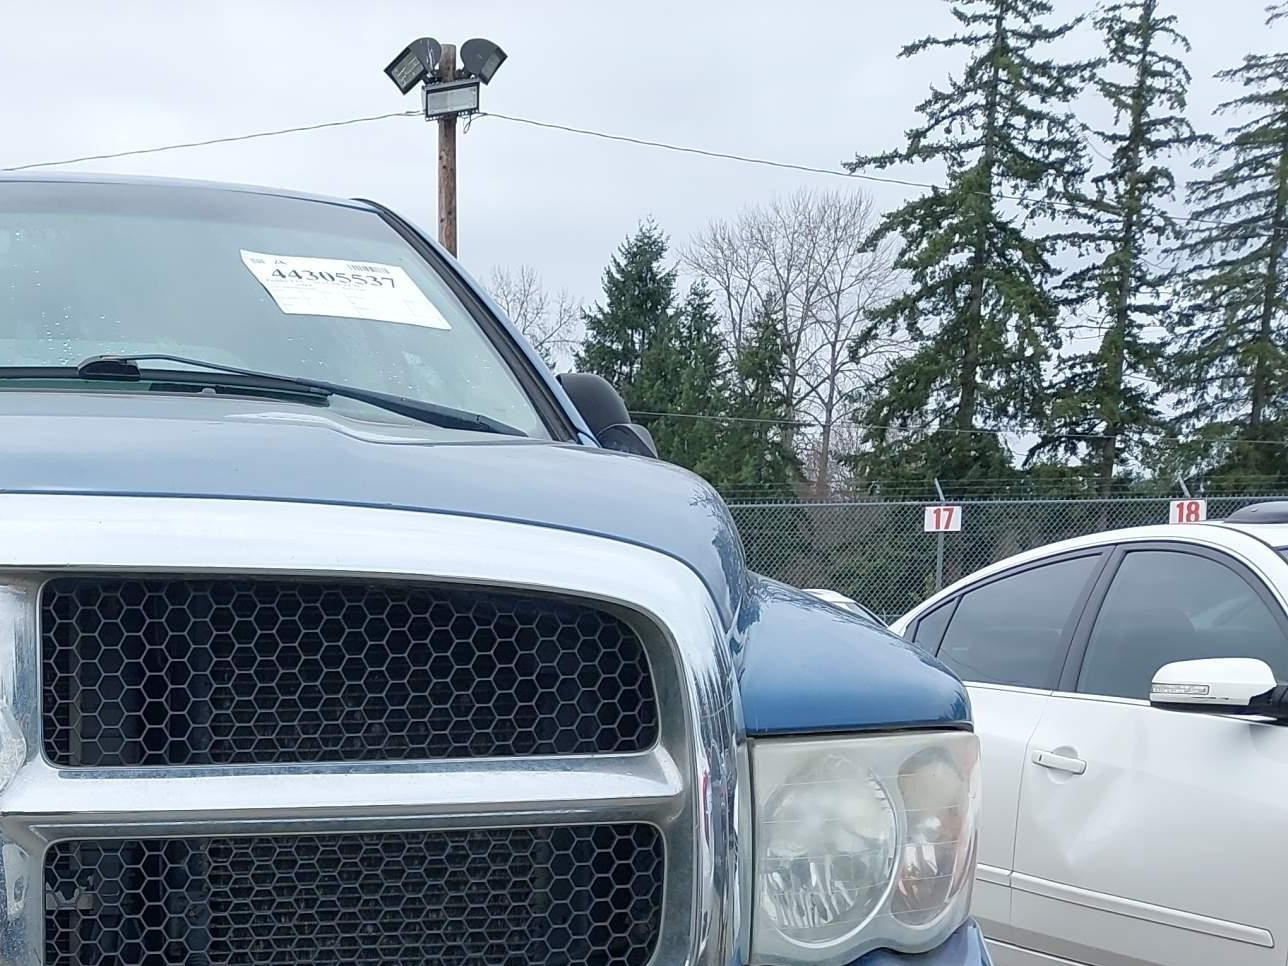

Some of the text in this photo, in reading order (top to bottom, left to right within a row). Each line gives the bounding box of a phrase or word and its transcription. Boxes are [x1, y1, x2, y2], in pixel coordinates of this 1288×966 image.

[271, 268, 396, 289] 44305537
[933, 507, 955, 530] 17
[1176, 501, 1200, 523] 18
